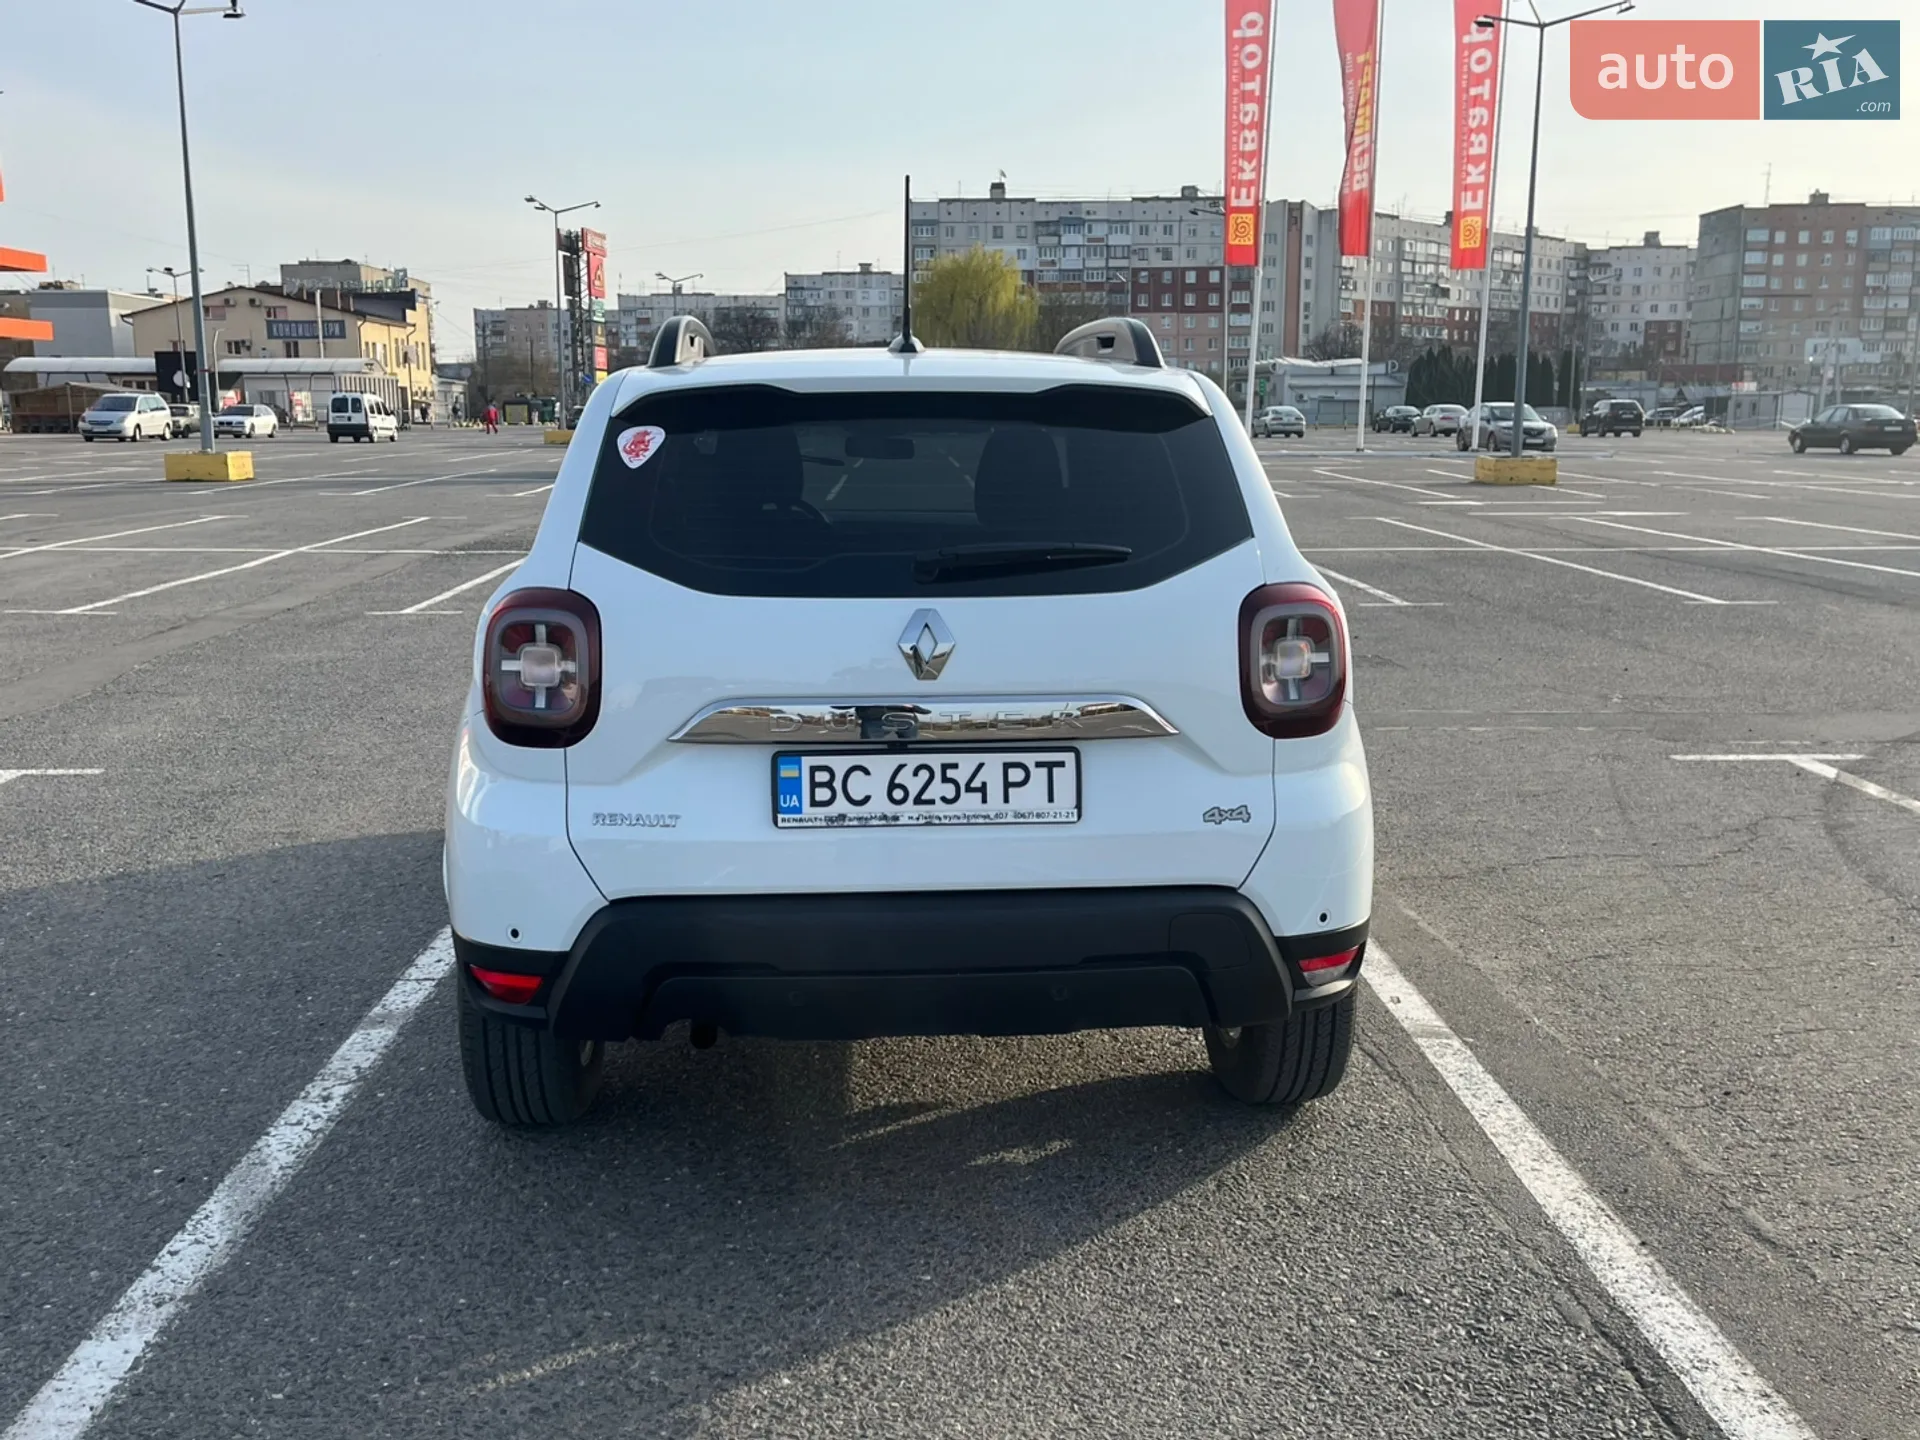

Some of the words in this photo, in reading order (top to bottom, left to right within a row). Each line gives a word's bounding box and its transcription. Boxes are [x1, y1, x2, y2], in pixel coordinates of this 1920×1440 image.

[272, 322, 340, 337] КОНДИЦІОЕРИ
[768, 709, 1084, 733] DUSTER
[809, 764, 872, 808] BC
[886, 762, 988, 806] 6254
[1002, 760, 1066, 804] PT
[779, 794, 799, 808] UA
[592, 812, 682, 828] RENAULT
[1202, 804, 1252, 825] 4x4
